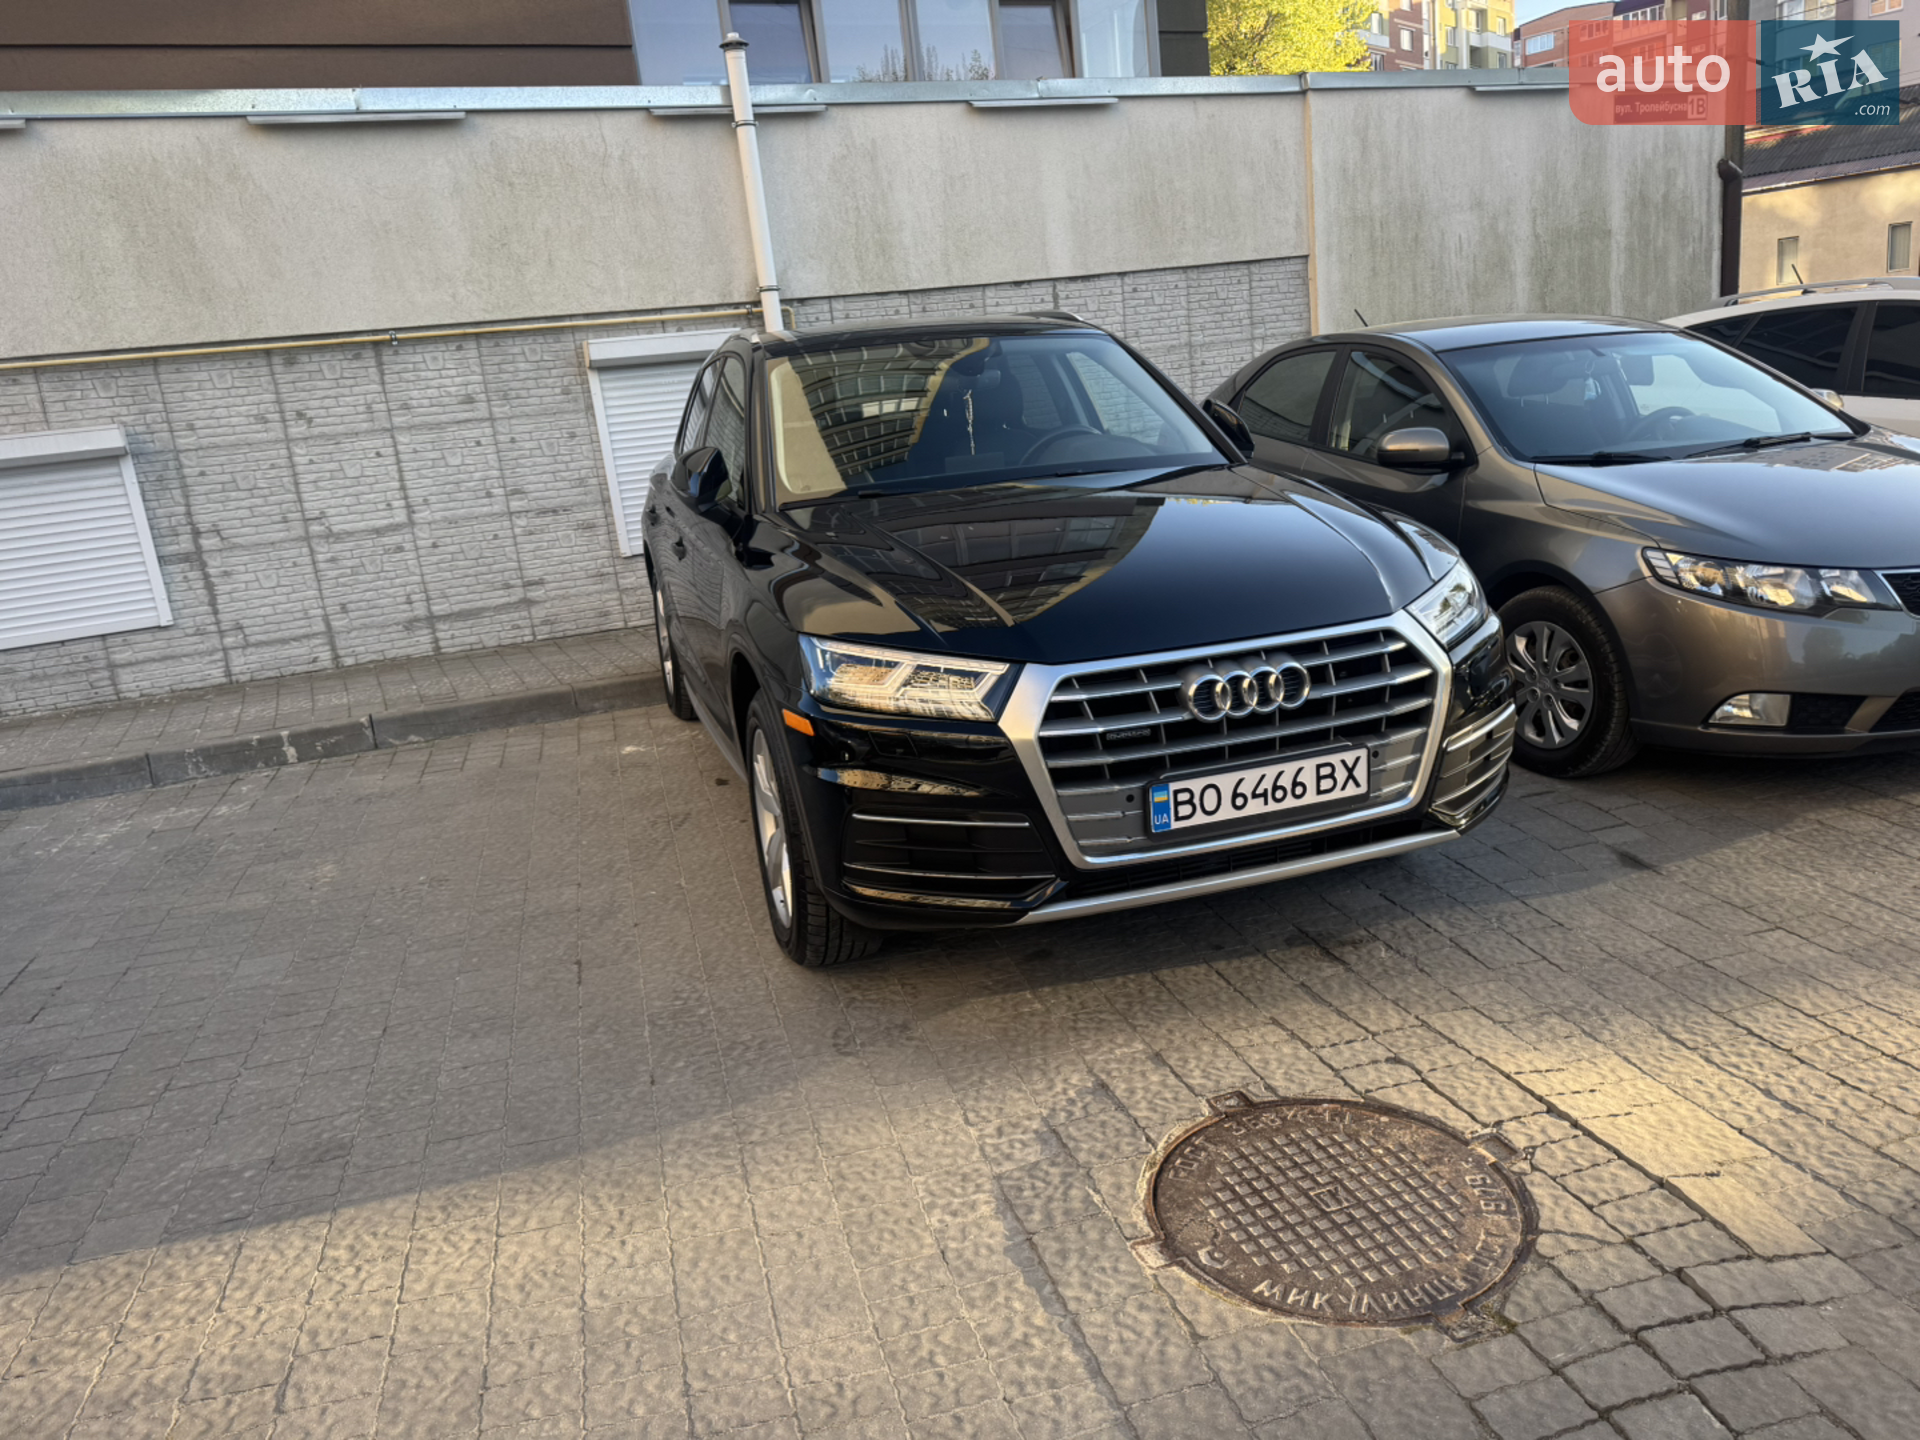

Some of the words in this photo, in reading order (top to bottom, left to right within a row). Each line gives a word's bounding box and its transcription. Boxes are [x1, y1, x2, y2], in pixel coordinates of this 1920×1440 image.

[1615, 104, 1633, 116] вул.
[1172, 783, 1222, 822] BO
[1230, 766, 1308, 811] 6466
[1315, 755, 1362, 796] BX
[1154, 812, 1169, 825] UA
